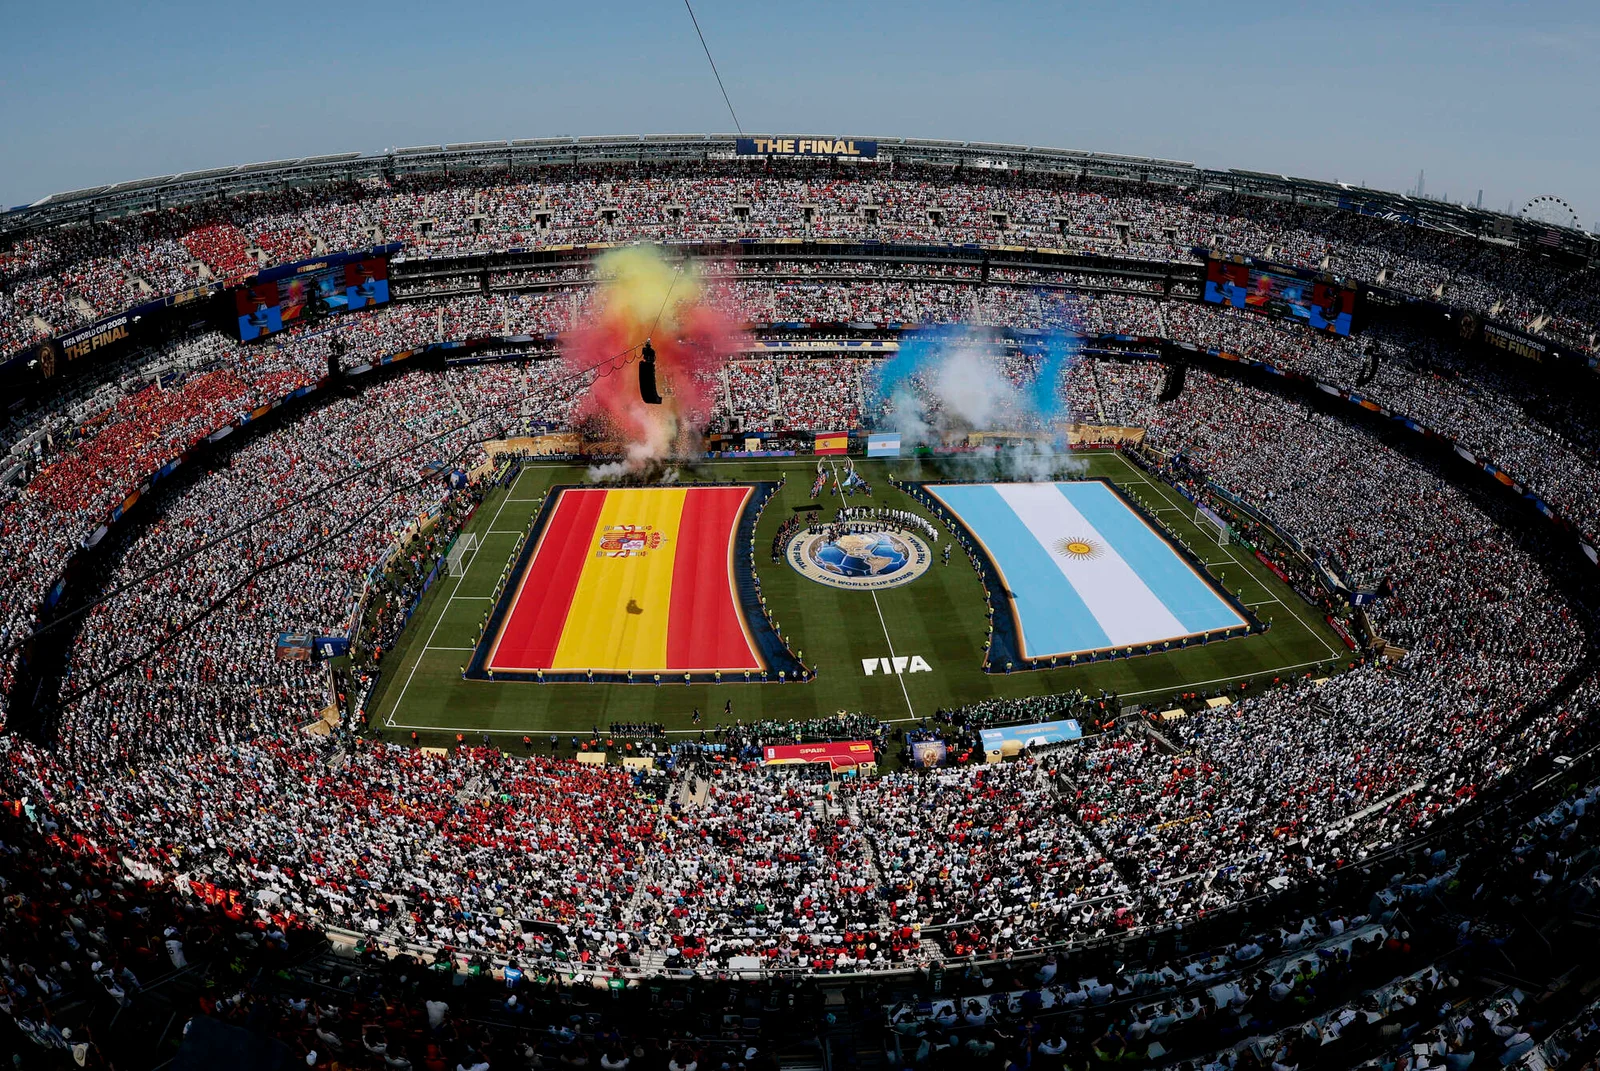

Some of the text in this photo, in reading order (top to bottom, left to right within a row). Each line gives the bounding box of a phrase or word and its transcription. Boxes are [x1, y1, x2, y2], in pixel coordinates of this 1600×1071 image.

[753, 139, 860, 155] THE FINAL
[62, 316, 128, 348] FIFA WORLD CUP 2026
[64, 325, 129, 361] THE FINAL
[1484, 324, 1546, 352] FIFA WORLD CUP 2026
[1484, 333, 1545, 366] THE FINAL
[792, 540, 808, 570] THE FINAL
[908, 536, 926, 565] THE FINAL
[818, 574, 837, 584] FIFA
[888, 571, 914, 585] 2026
[861, 655, 933, 676] FIFA
